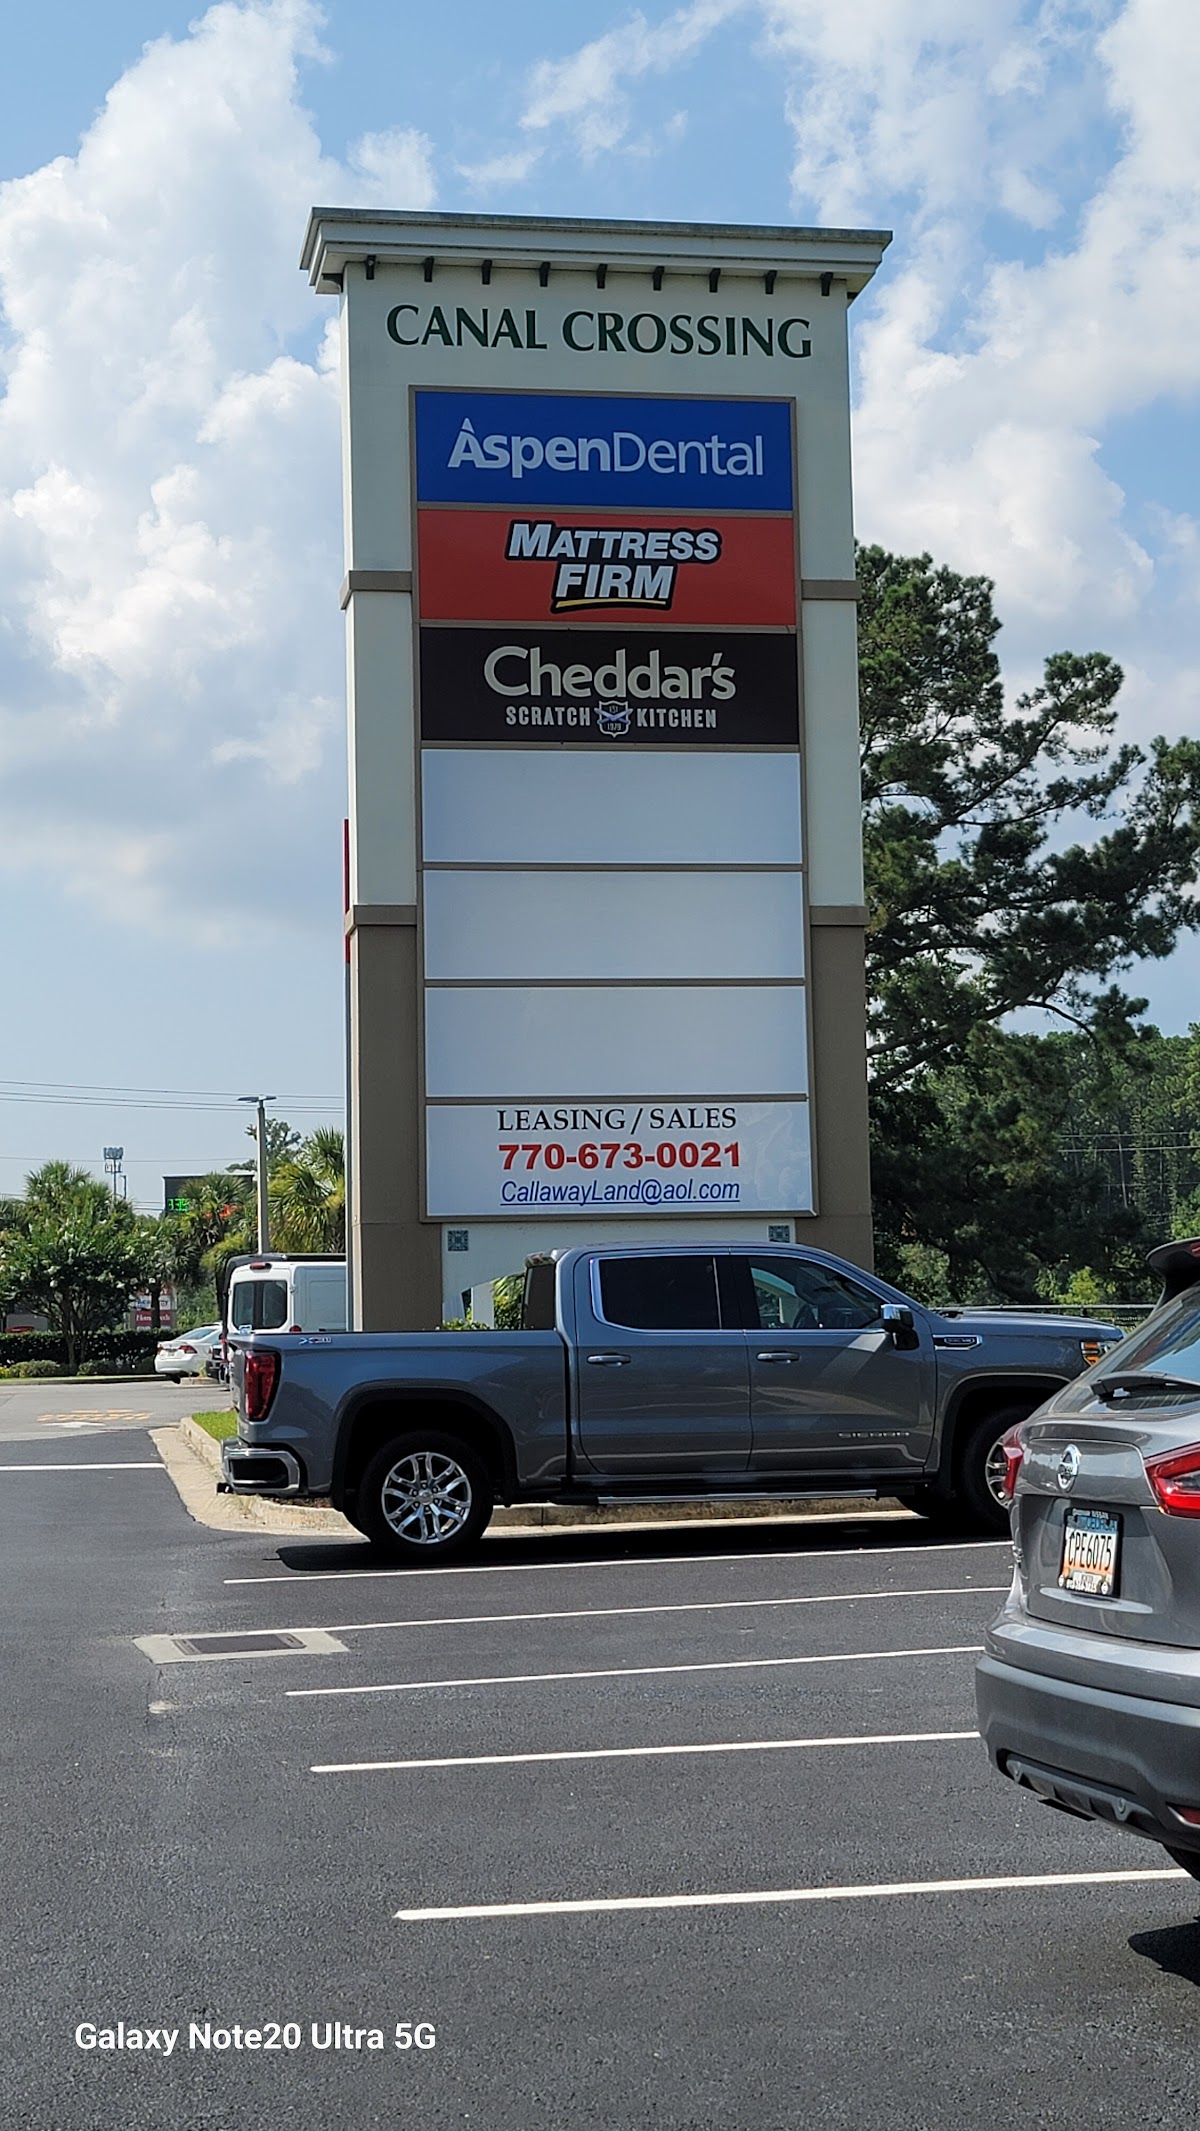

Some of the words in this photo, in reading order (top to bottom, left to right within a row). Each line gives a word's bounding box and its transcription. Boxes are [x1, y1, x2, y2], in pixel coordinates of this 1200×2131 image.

[387, 304, 547, 350] CANAL
[562, 311, 812, 359] CROSSING
[508, 523, 719, 560] MATTRESS
[555, 564, 674, 599] FIRM
[484, 645, 736, 700] Cheddar's
[506, 707, 591, 726] SCRATCH
[637, 708, 717, 728] KITCHEN
[497, 1109, 626, 1131] LEASING
[649, 1108, 737, 1129] SALES
[499, 1142, 740, 1170] 770-673-0021
[501, 1179, 740, 1206] CallawayLand@aol.com
[1069, 1530, 1112, 1572] CPE6075
